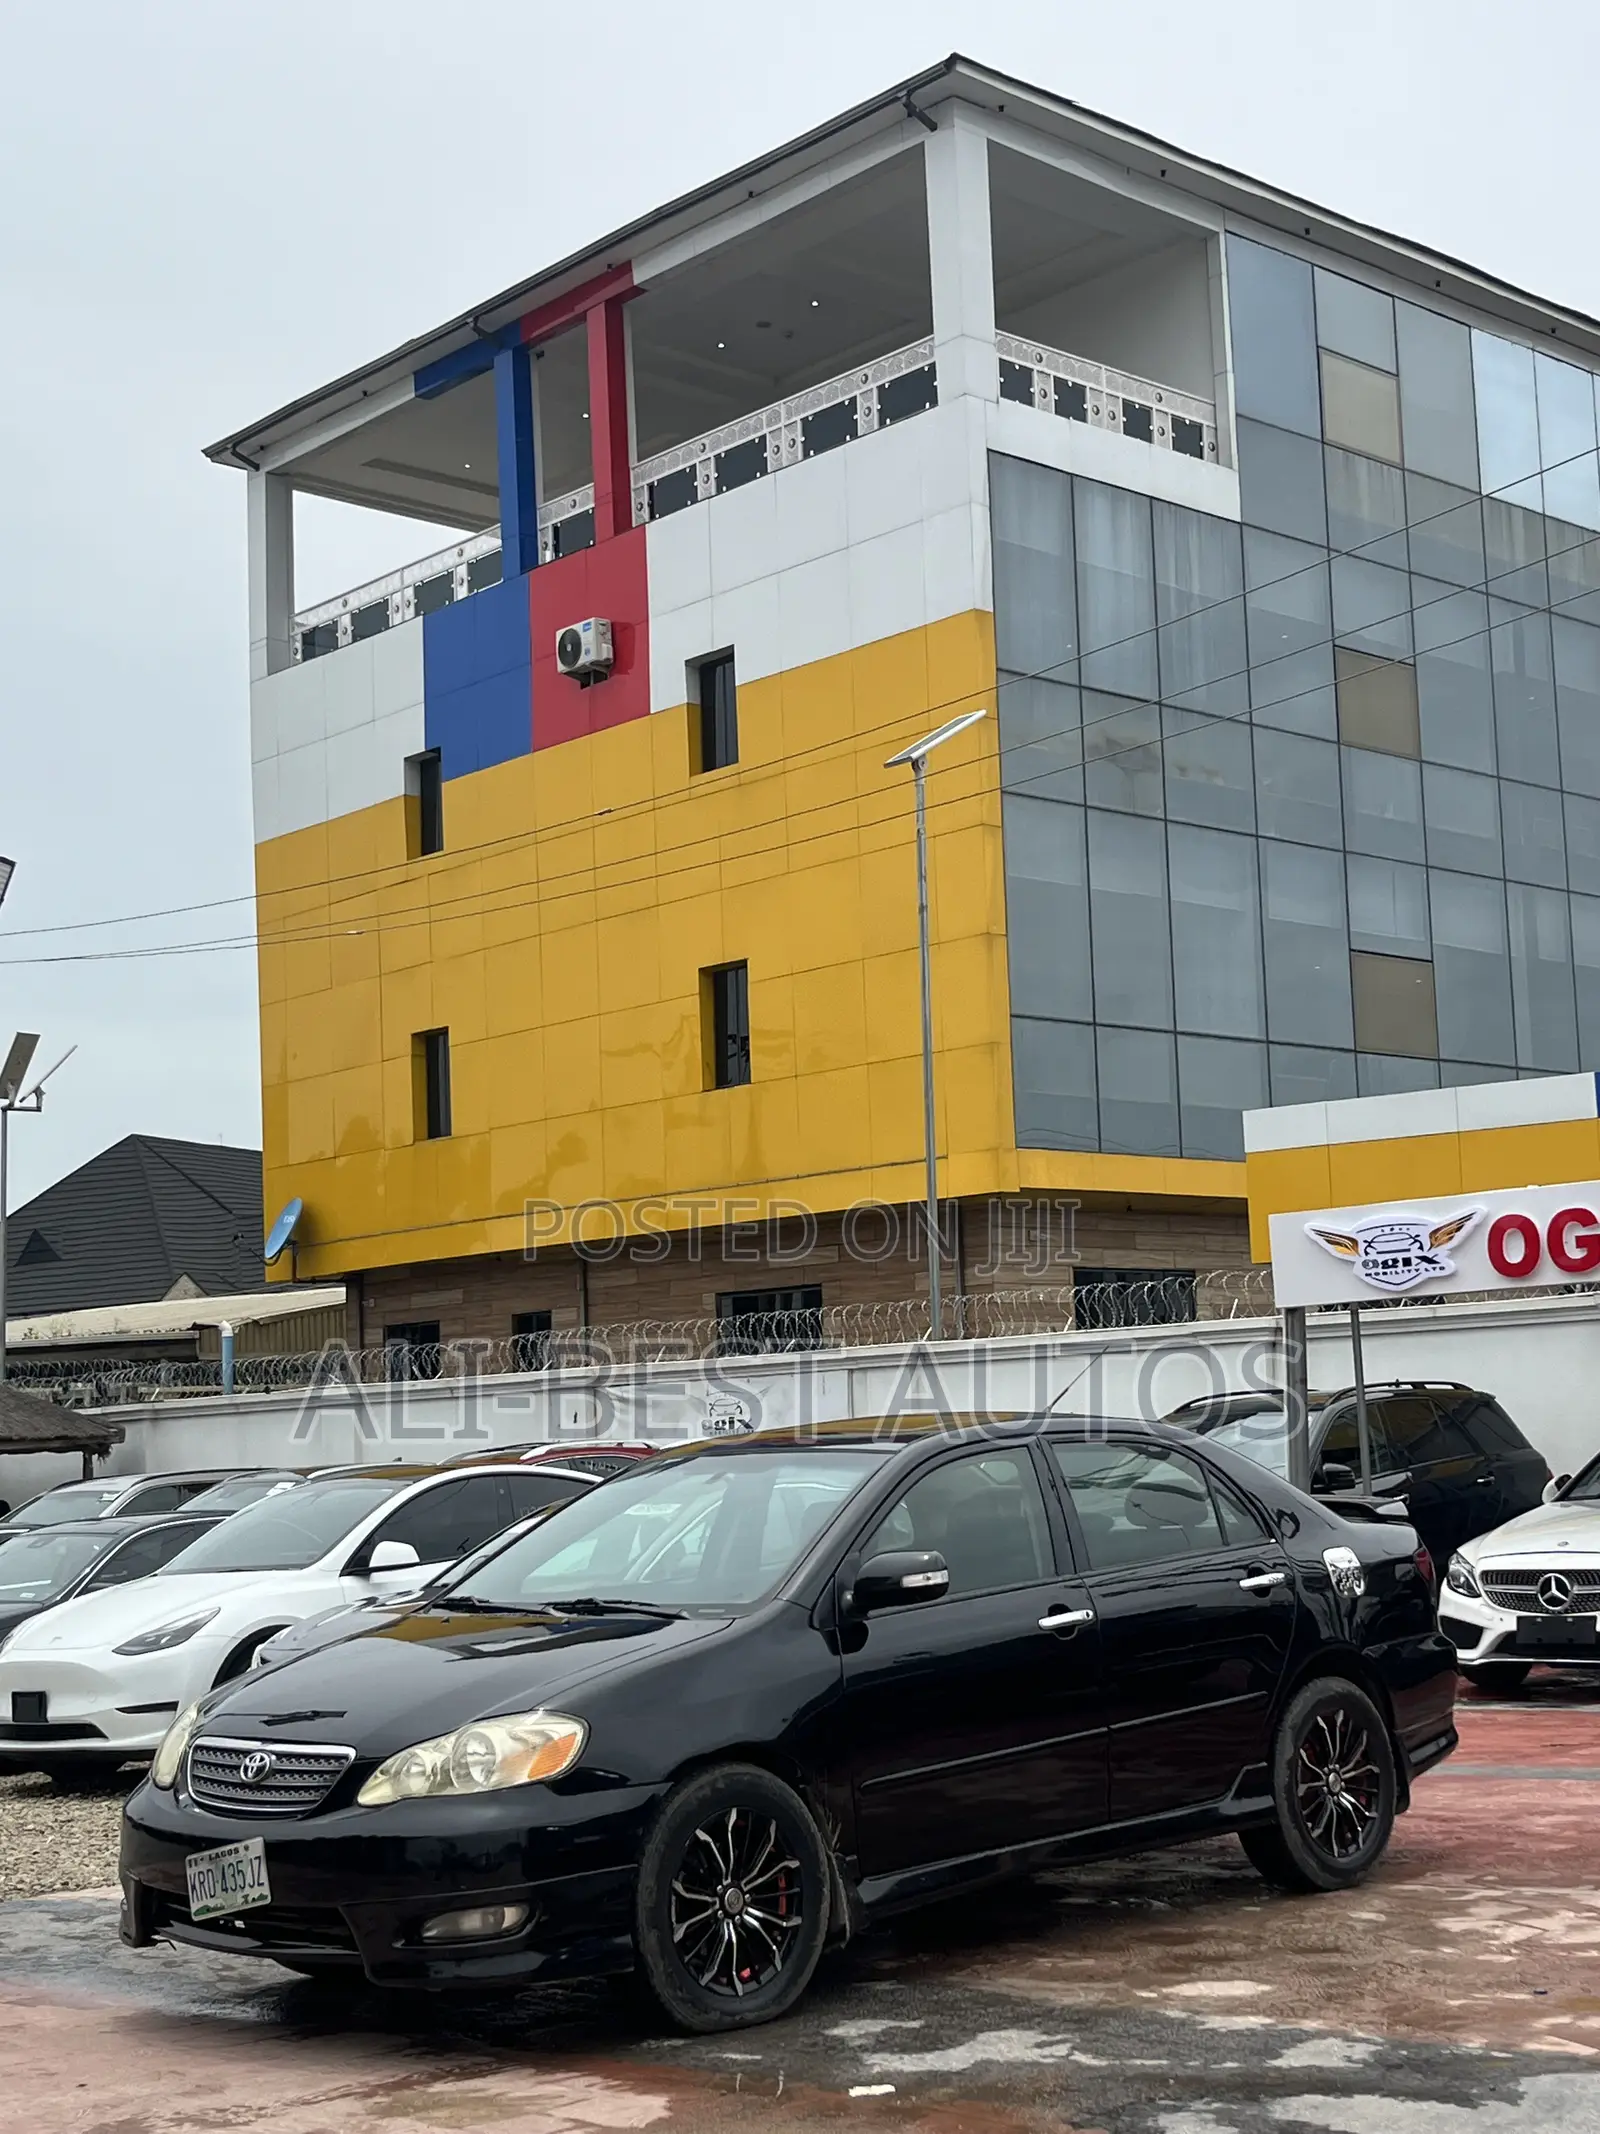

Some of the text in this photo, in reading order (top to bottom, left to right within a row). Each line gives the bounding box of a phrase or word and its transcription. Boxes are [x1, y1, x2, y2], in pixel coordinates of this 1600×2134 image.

[1487, 1207, 1600, 1278] OG
[1364, 1265, 1446, 1277] MOBILITY LTD
[208, 1846, 240, 1861] LAGOS
